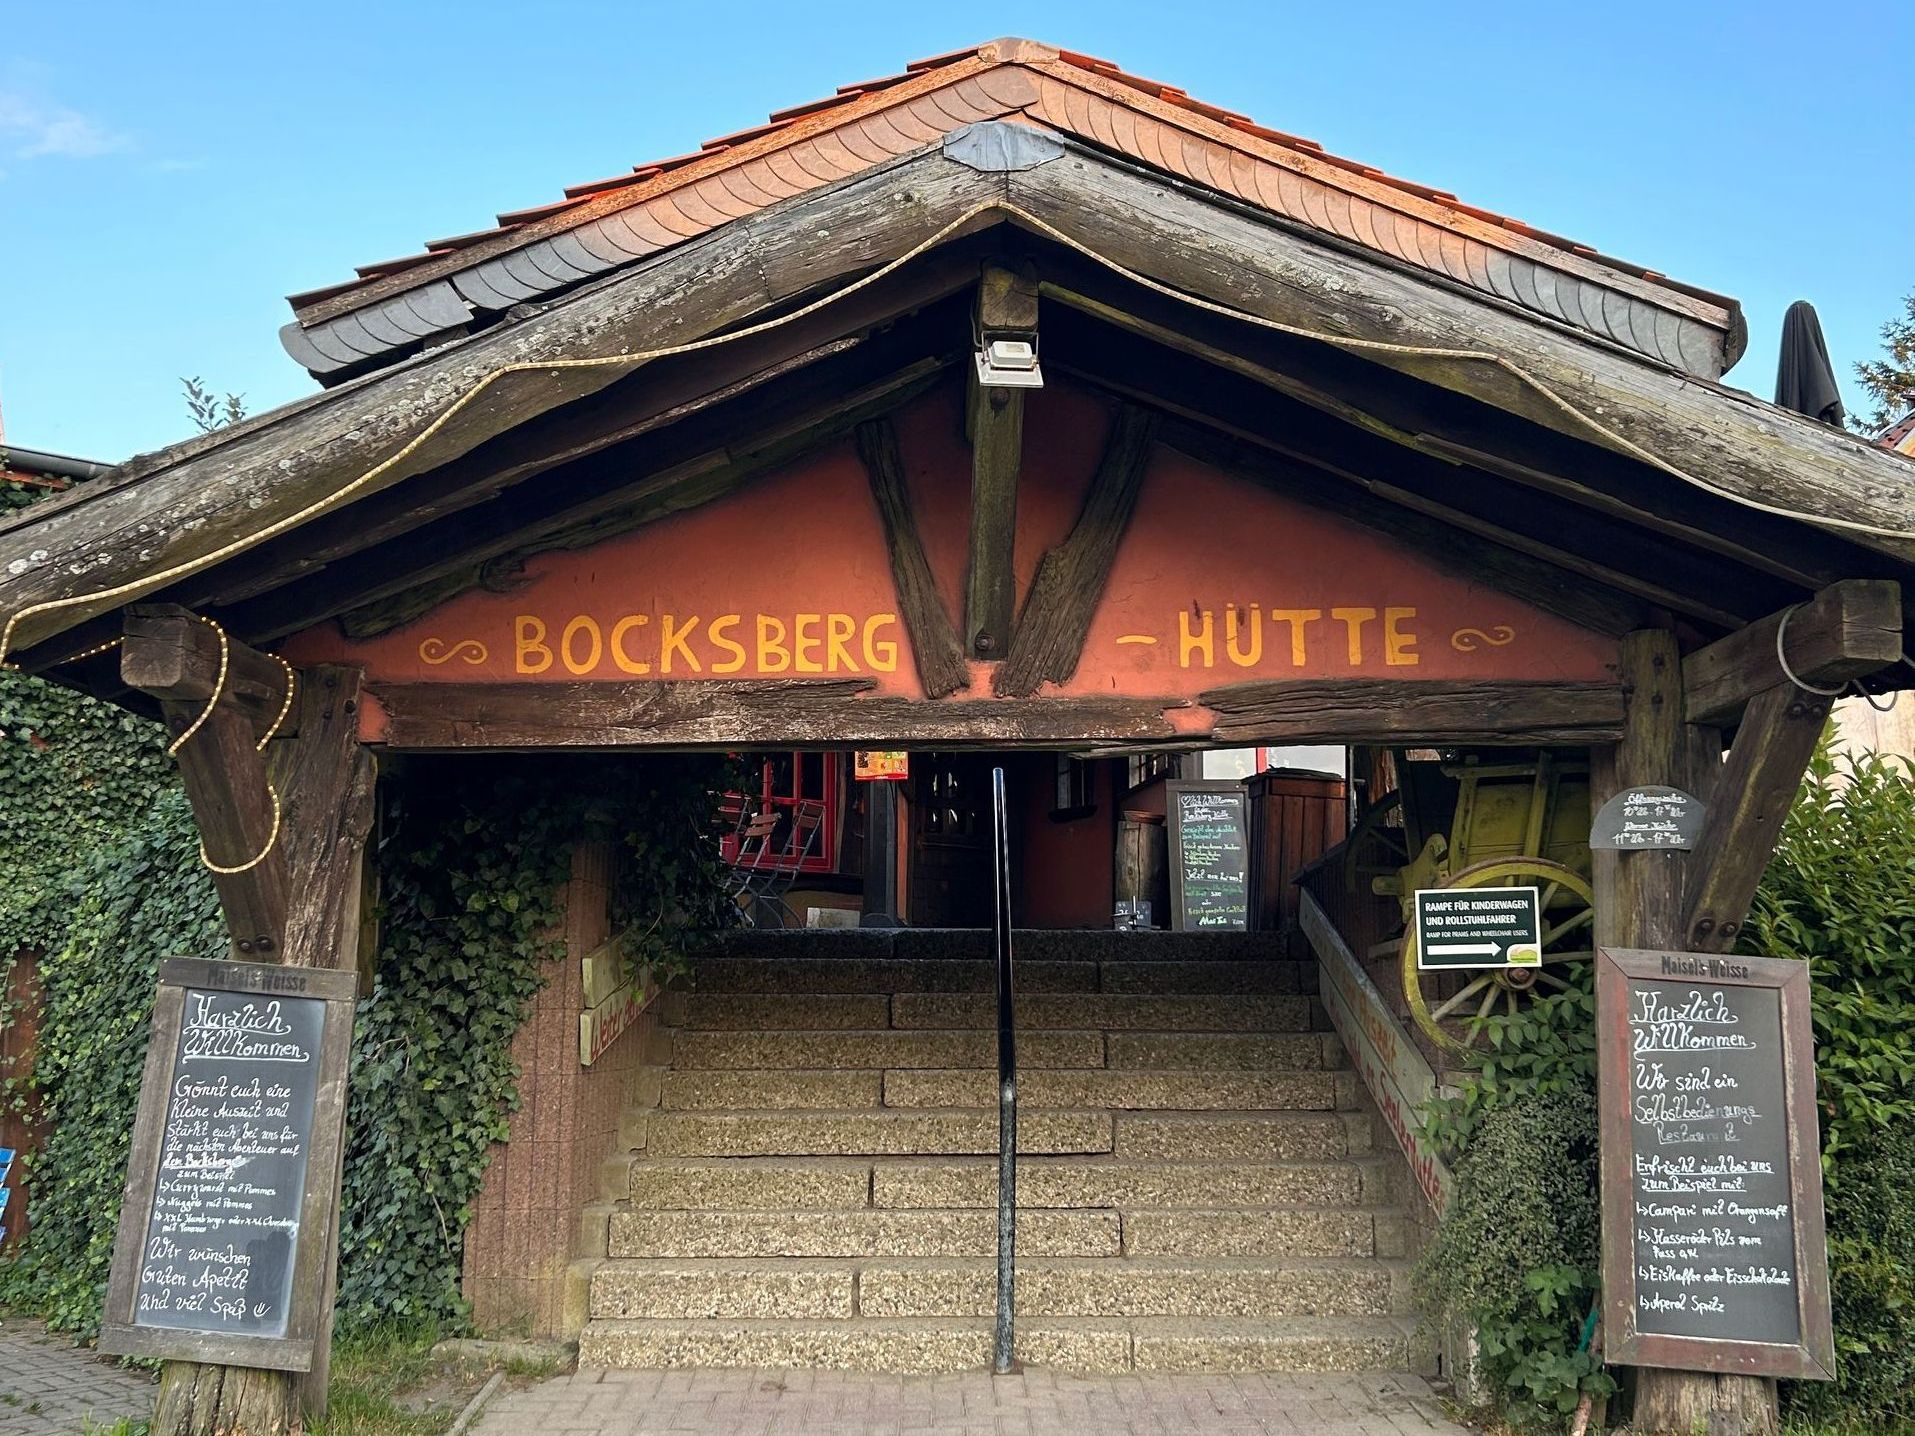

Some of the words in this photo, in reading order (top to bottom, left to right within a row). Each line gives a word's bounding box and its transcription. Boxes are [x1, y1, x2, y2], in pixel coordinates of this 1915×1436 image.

[515, 614, 898, 674] BOCKSBERG
[1179, 603, 1419, 668] HÜTTE
[1425, 902, 1453, 912] RAMPE
[1454, 900, 1470, 911] FÜR
[1471, 900, 1528, 910] KINDERWAGEN
[1426, 916, 1443, 926] UND
[1445, 915, 1516, 925] ROLLSTUHLFAHRER
[175, 1075, 229, 1098] Gönnt
[230, 1077, 261, 1098] euch
[265, 1083, 291, 1098] eine
[1636, 1063, 1670, 1091] Wir
[1675, 1067, 1711, 1091] sind
[1714, 1073, 1738, 1088] ein
[214, 1100, 262, 1119] Auszeit
[266, 1102, 289, 1118] und
[212, 1124, 237, 1138] euch
[242, 1122, 258, 1139] bei
[262, 1130, 278, 1140] uns
[279, 1125, 299, 1143] für
[166, 1136, 182, 1152] die
[186, 1137, 226, 1152] nächsten
[228, 1139, 278, 1154] Abenteuer
[280, 1144, 300, 1157] auf
[1635, 1154, 1695, 1175] Erfrischt
[1700, 1154, 1727, 1173] euch
[1727, 1156, 1747, 1172] bei
[1750, 1161, 1772, 1172] uns
[228, 1182, 243, 1193] mit
[1669, 1176, 1717, 1194] Beispiel
[206, 1197, 221, 1208] mit
[1649, 1203, 1697, 1223] Campari
[1702, 1199, 1725, 1216] mit
[1727, 1202, 1788, 1224] Orangensaft
[1712, 1226, 1735, 1247] Pils
[150, 1237, 182, 1260] Wir
[188, 1244, 251, 1266] wünschen
[1652, 1246, 1675, 1259] Fass
[142, 1265, 186, 1286] Guten
[1704, 1267, 1725, 1282] oder
[175, 1291, 207, 1311] viel
[210, 1296, 246, 1320] Spaß
[1650, 1292, 1687, 1314] Aperol
[1691, 1295, 1725, 1316] Spritz
